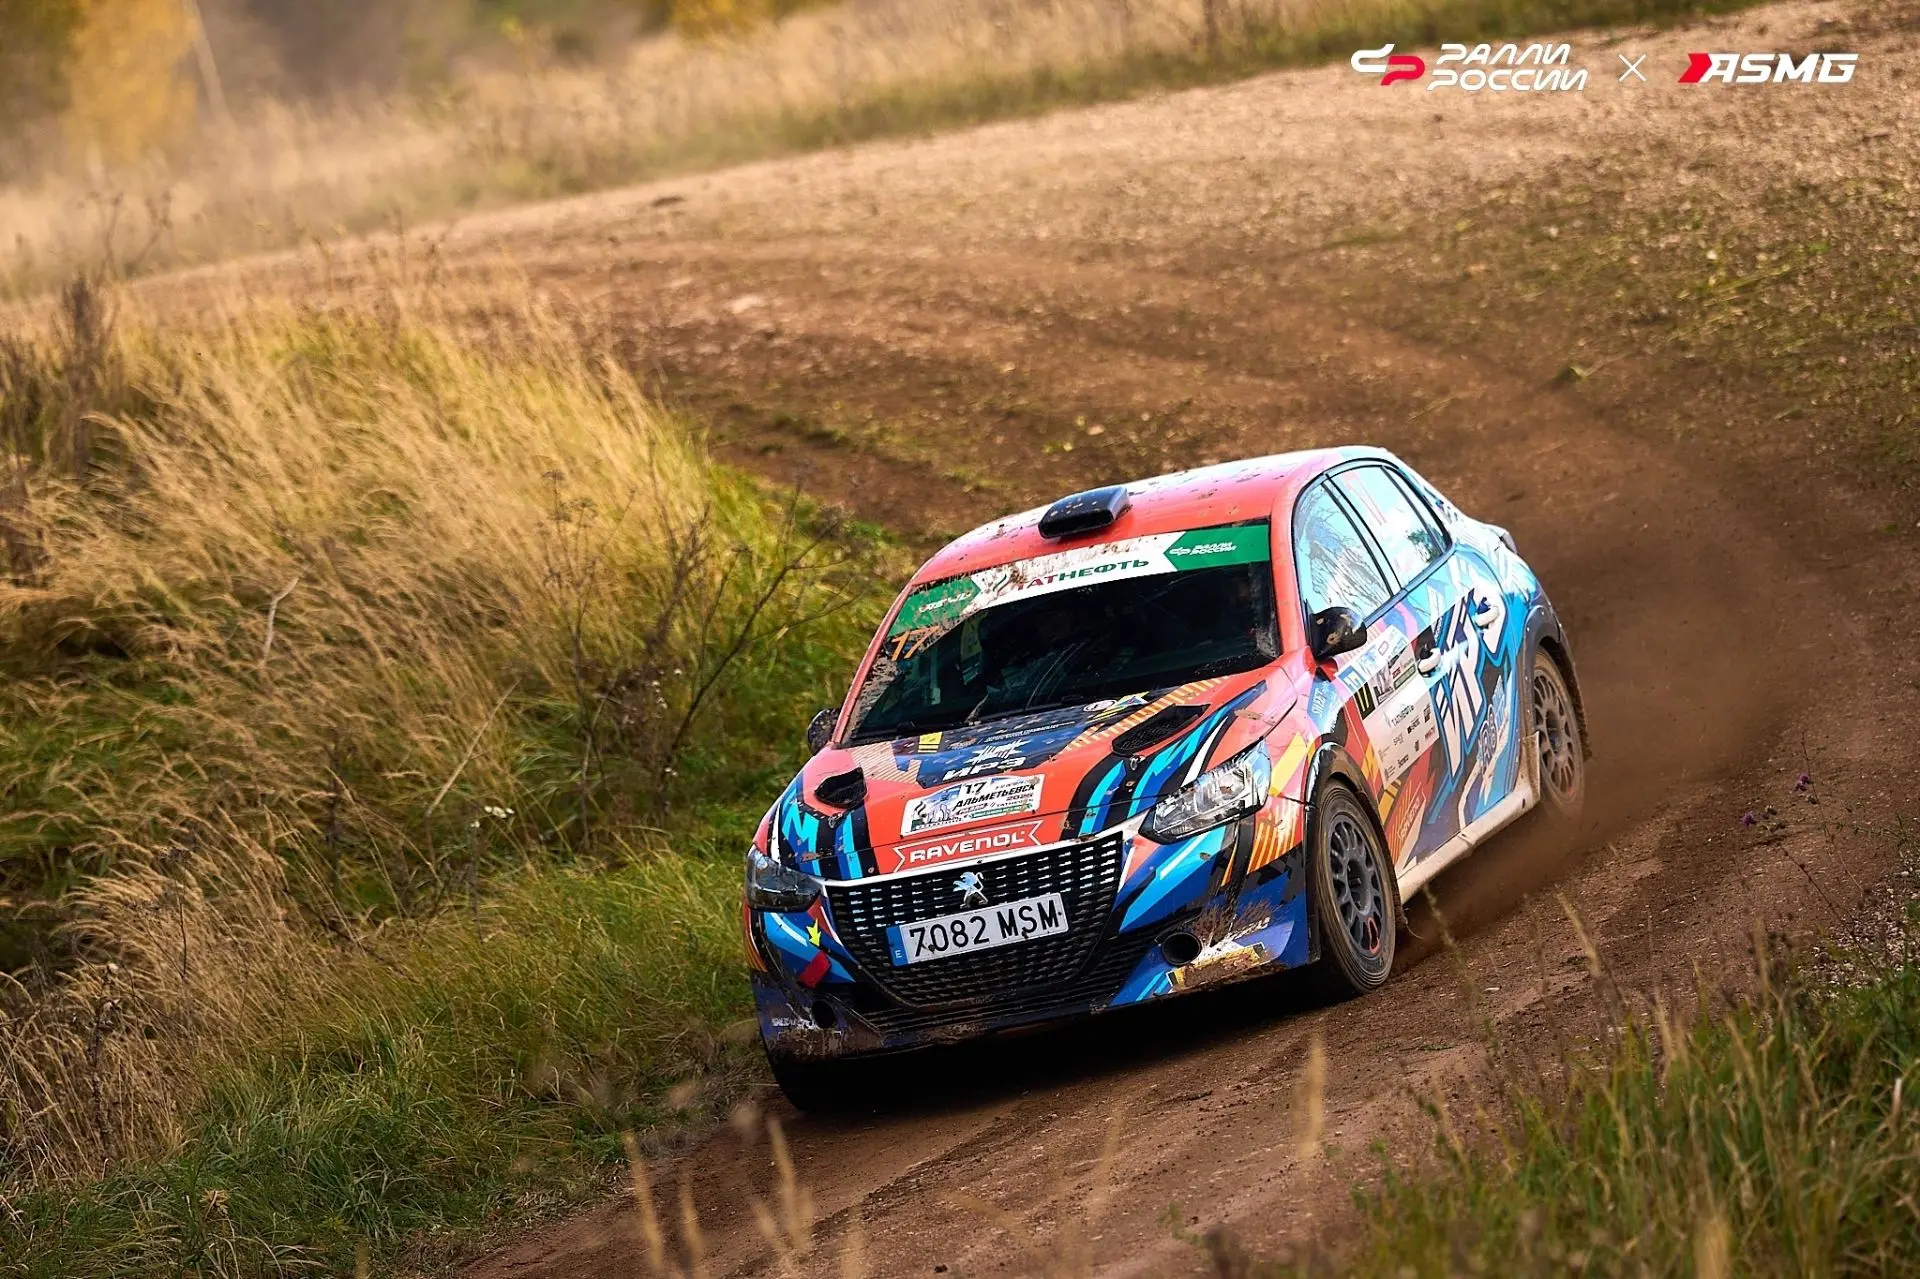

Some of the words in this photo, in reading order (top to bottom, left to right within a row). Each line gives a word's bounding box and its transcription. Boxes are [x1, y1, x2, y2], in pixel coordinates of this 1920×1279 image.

[891, 625, 940, 662] 17
[952, 784, 1036, 812] АЛЬМЕТЬЕВСК
[910, 832, 1025, 863] RAVENOL
[909, 916, 990, 957] 7082
[997, 900, 1059, 939] MSM
[895, 950, 902, 959] E
